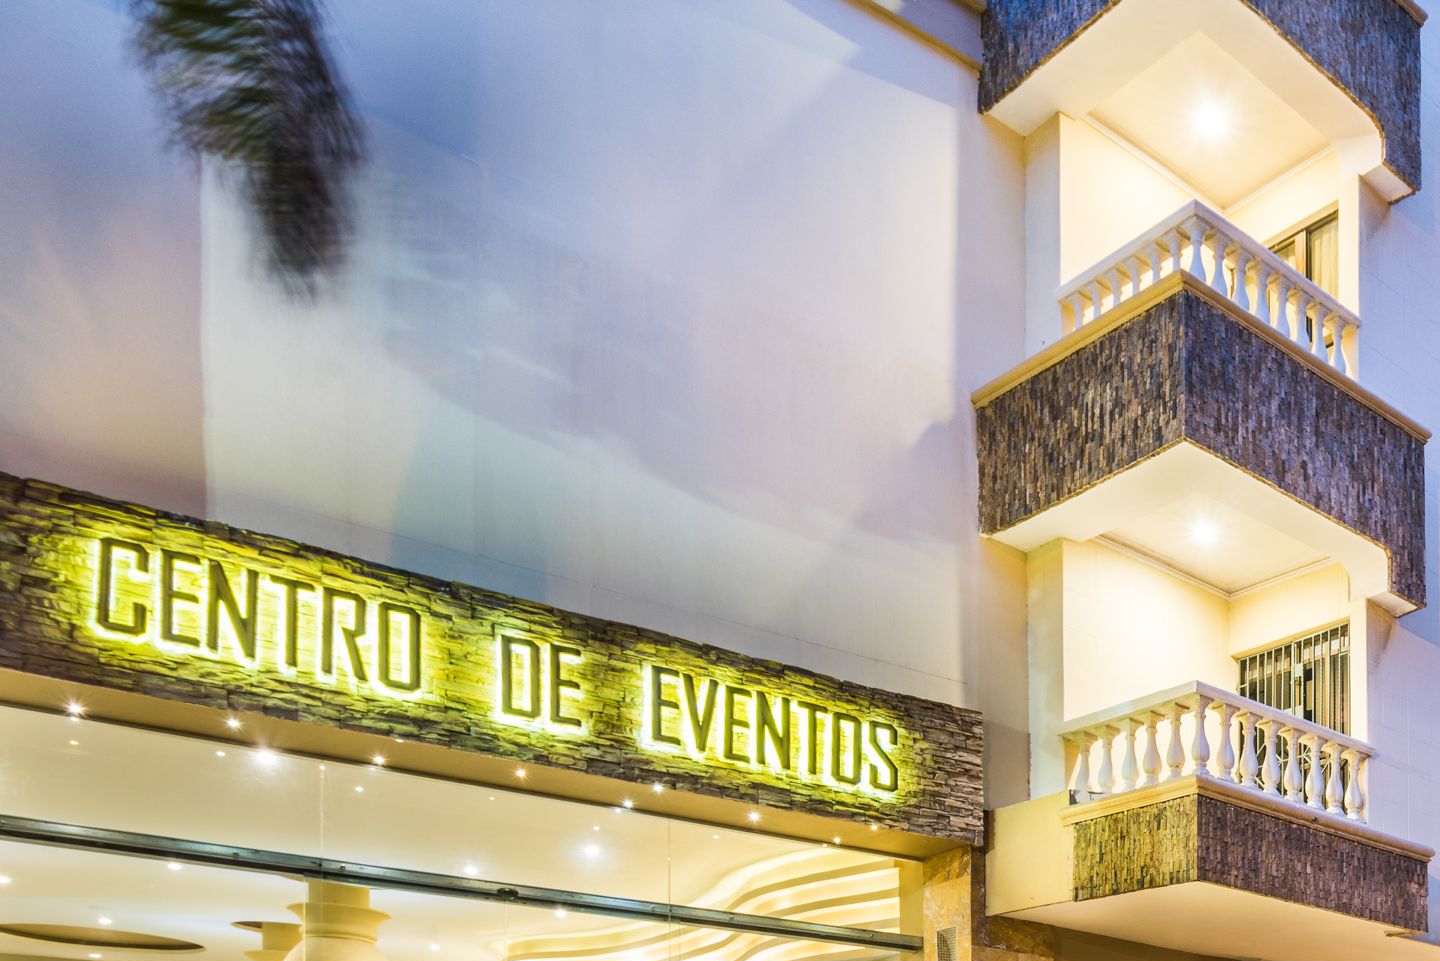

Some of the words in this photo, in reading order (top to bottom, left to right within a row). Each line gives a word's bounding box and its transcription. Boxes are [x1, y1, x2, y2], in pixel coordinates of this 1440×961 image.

[96, 536, 422, 692] CENTRO
[501, 633, 582, 727] DE
[651, 665, 899, 792] EVENTOS
